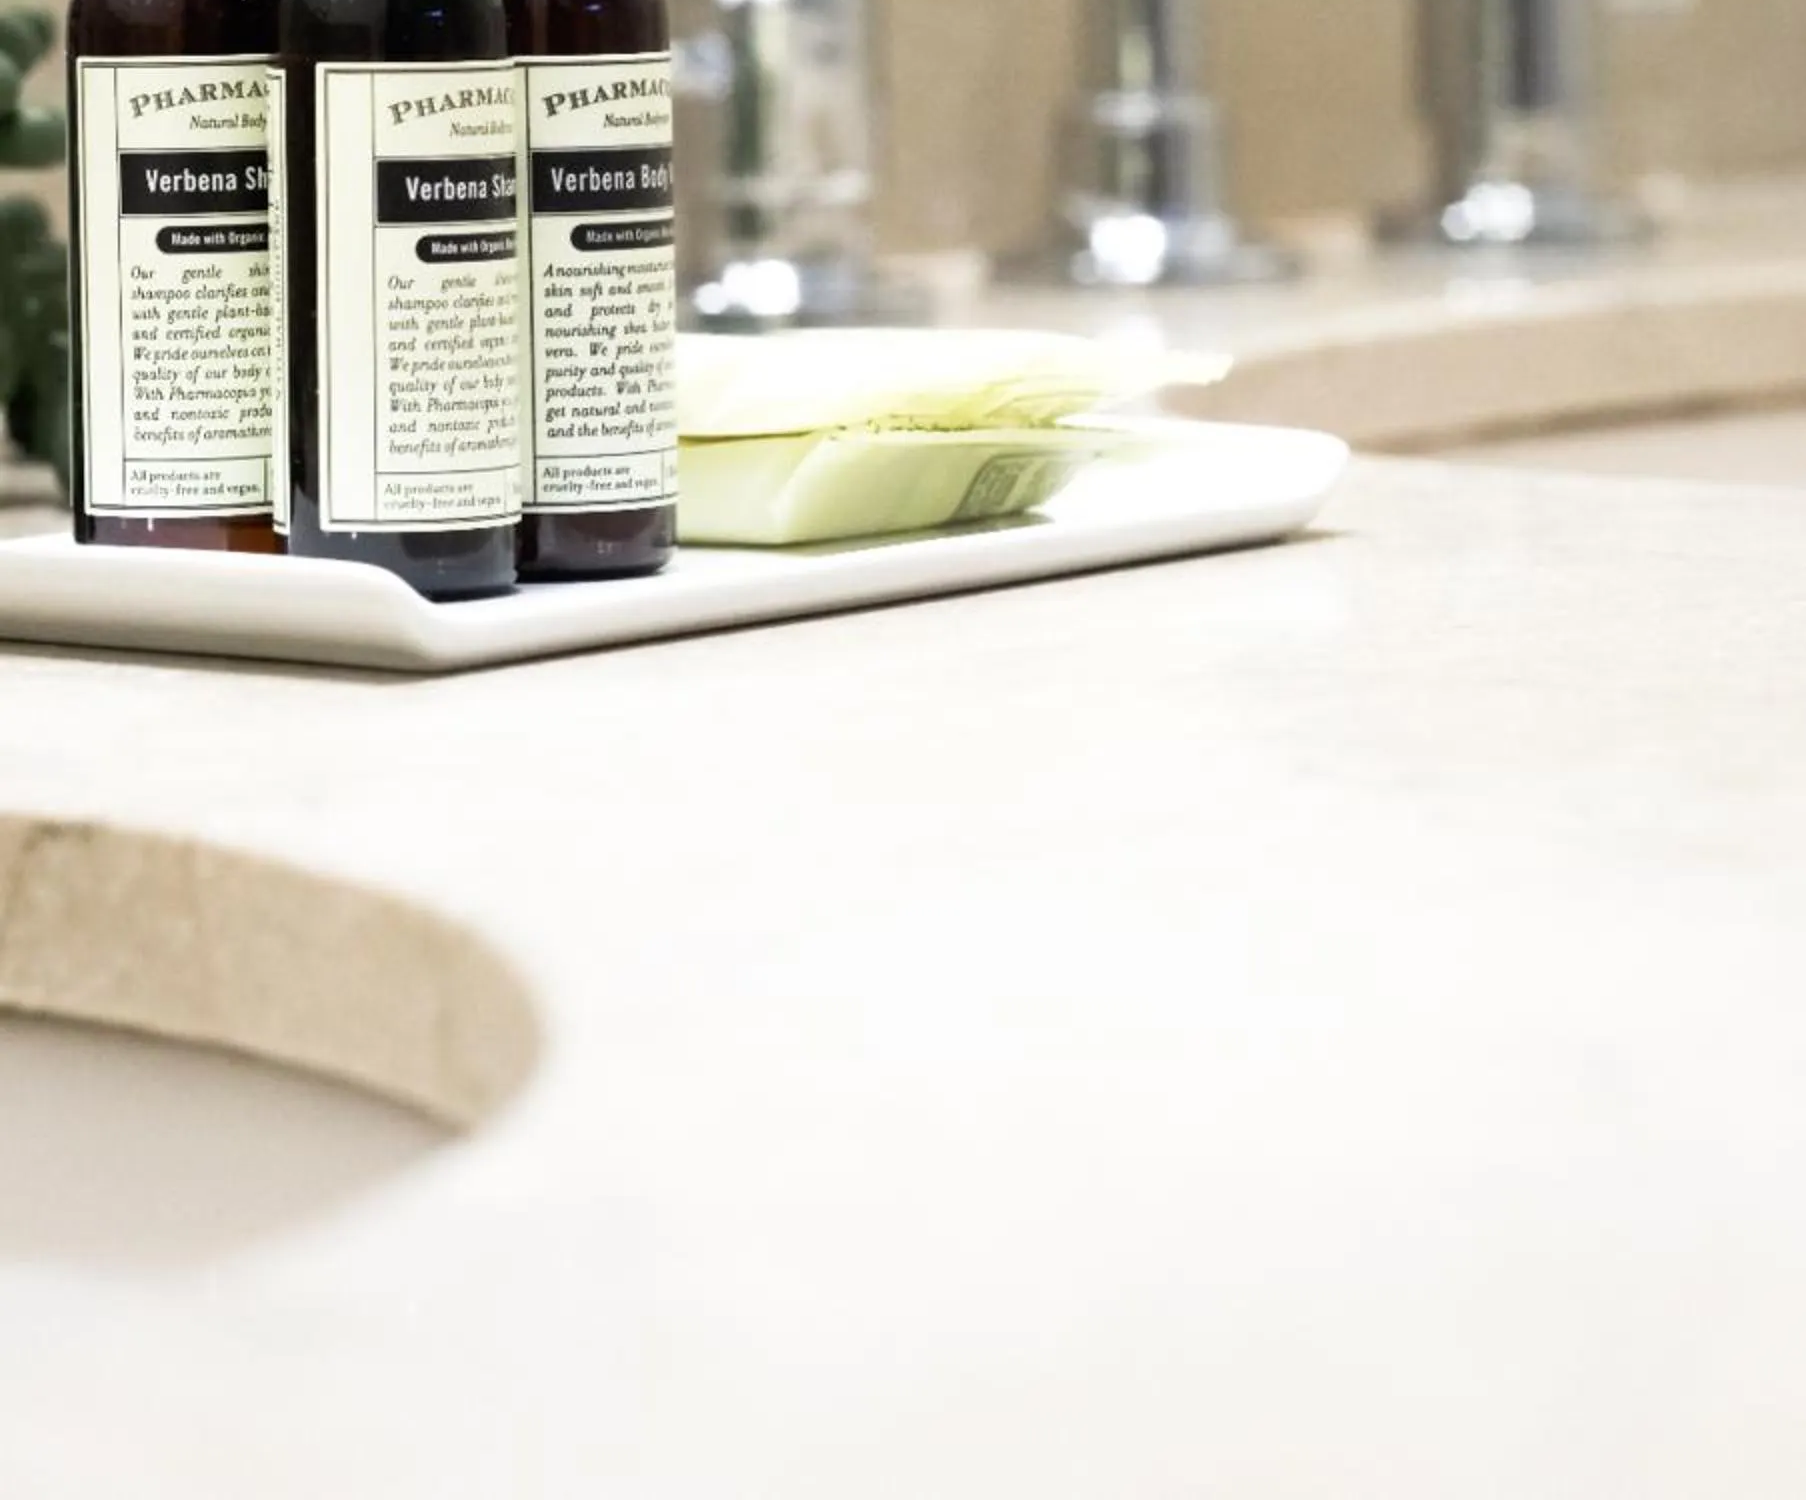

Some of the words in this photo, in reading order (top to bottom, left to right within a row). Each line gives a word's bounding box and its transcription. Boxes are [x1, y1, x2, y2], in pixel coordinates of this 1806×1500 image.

[189, 114, 239, 130] Natural
[145, 167, 237, 193] Verbena
[551, 165, 635, 193] Verbena
[640, 163, 668, 192] Body
[405, 175, 488, 202] Verbena
[171, 232, 201, 246] Made
[204, 231, 226, 245] with
[228, 231, 265, 247] Organic
[585, 229, 613, 244] Made
[615, 228, 634, 243] with
[431, 241, 458, 255] Made
[460, 239, 479, 254] with
[130, 265, 155, 280] Our
[181, 264, 223, 284] gentle
[543, 263, 553, 277] A
[555, 262, 625, 279] nourishing
[387, 275, 415, 291] Our
[441, 273, 478, 292] gentle
[544, 283, 573, 298] skin
[580, 280, 603, 301] soft
[608, 280, 633, 296] and
[131, 286, 192, 304] shampoo
[195, 283, 249, 303] clarifies
[387, 296, 449, 315] shampoo
[544, 303, 573, 318] and
[132, 306, 161, 320] with
[167, 306, 209, 325] gentle
[388, 316, 419, 332] with
[426, 313, 465, 335] gentle
[132, 326, 159, 341] and
[165, 325, 222, 345] certified
[544, 323, 617, 340] nourishing
[388, 336, 417, 352] and
[424, 334, 474, 355] certified
[545, 347, 578, 358] vera.
[589, 341, 608, 357] We
[133, 347, 152, 361] We
[152, 347, 190, 365] pride
[190, 344, 249, 361] ourselves
[132, 366, 178, 385] quality
[185, 365, 201, 384] of
[204, 367, 228, 380] our
[232, 364, 262, 383] body
[389, 357, 409, 371] We
[410, 357, 445, 376] pride
[544, 367, 587, 383] purity
[589, 362, 616, 377] and
[133, 386, 164, 401] With
[389, 378, 437, 397] quality
[443, 375, 458, 395] of
[545, 383, 607, 403] products.
[616, 380, 642, 395] With
[133, 407, 160, 421] and
[171, 406, 231, 421] nontoxic
[390, 398, 421, 413] With
[545, 406, 566, 423] get
[571, 401, 621, 417] natural
[624, 400, 646, 415] and
[133, 425, 185, 445] benefits
[187, 425, 203, 445] of
[388, 420, 417, 433] and
[547, 423, 575, 438] and
[577, 422, 599, 437] the
[601, 419, 644, 440] benefits
[388, 439, 441, 458] benefits
[444, 437, 459, 457] of
[130, 469, 147, 482] All
[149, 469, 200, 484] products
[543, 467, 560, 479] All
[562, 465, 612, 481] products
[202, 483, 225, 495] and
[384, 483, 401, 496] All
